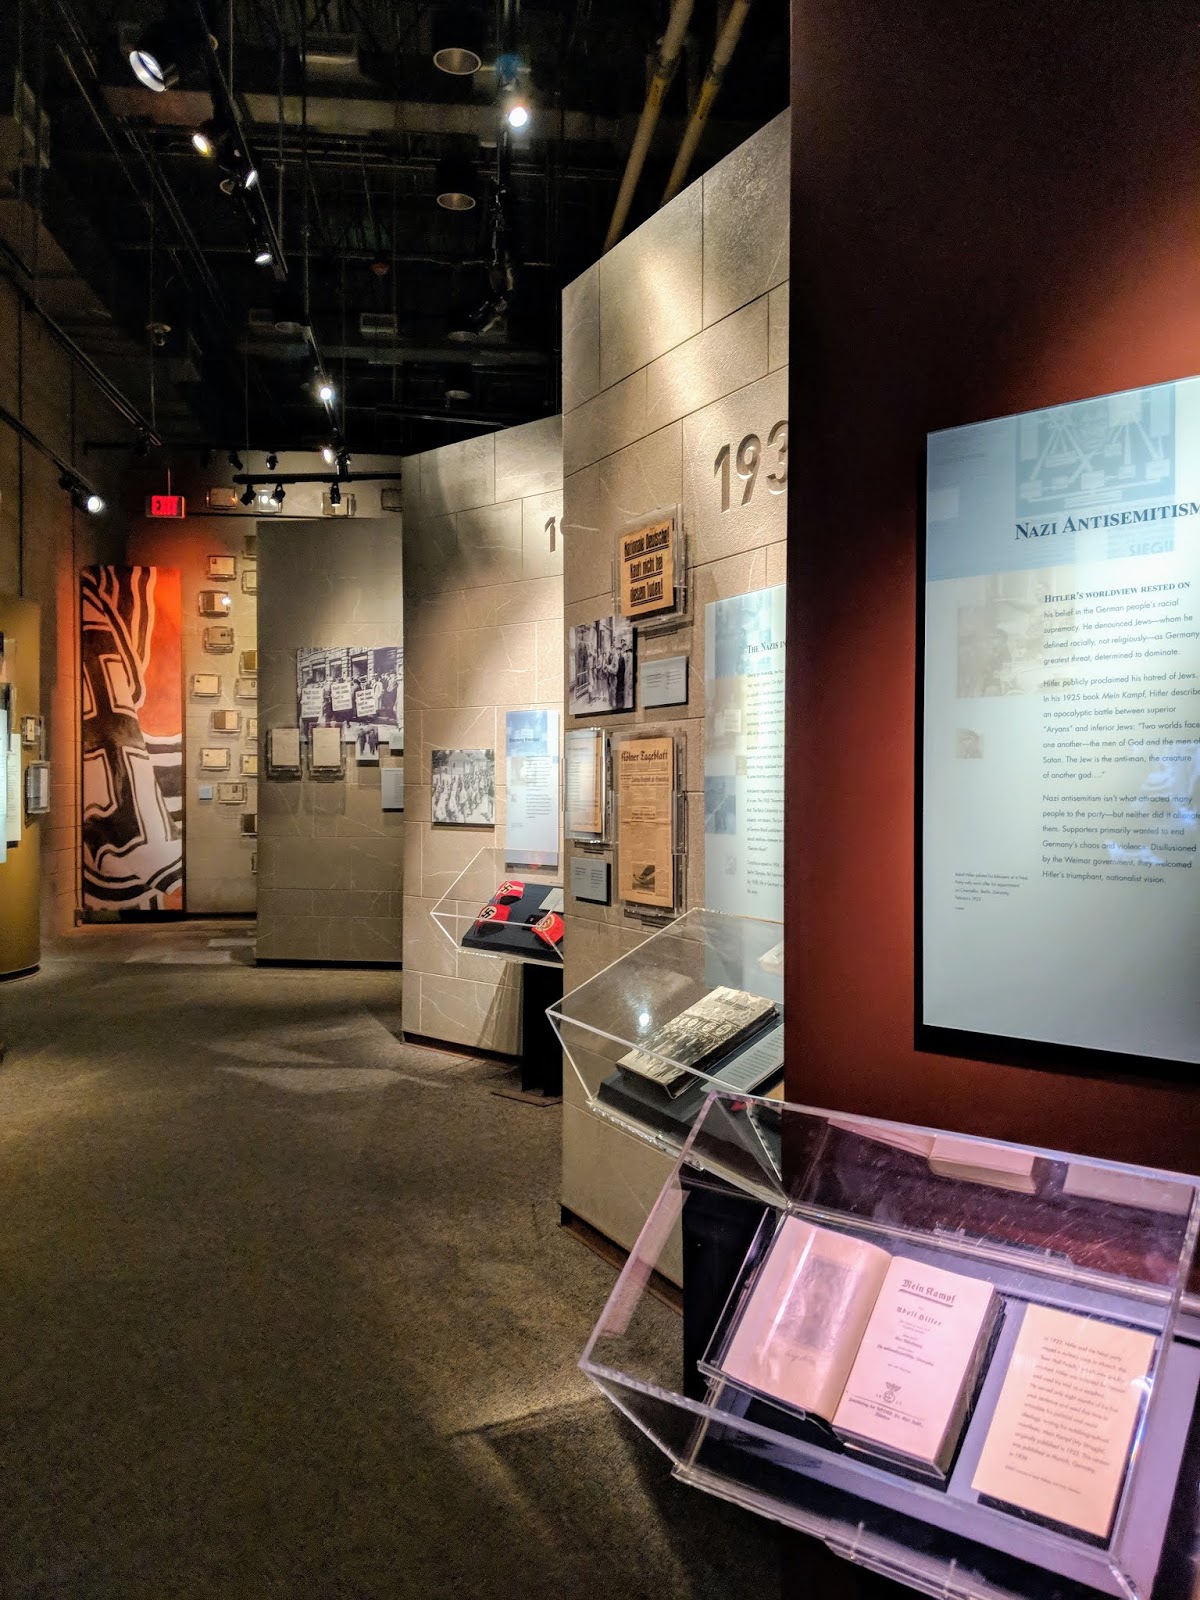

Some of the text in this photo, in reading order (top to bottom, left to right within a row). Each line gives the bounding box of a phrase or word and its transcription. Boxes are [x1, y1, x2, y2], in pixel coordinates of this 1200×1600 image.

[1044, 592, 1084, 603] HITLER'S
[1086, 587, 1138, 599] WORLDVIEW
[1141, 584, 1175, 593] RESTED
[1055, 609, 1074, 617] belief
[1096, 605, 1124, 613] German
[1126, 602, 1156, 612] people's
[1158, 599, 1179, 607] racial
[1044, 625, 1079, 634] supremacy.
[1095, 619, 1132, 628] denounced
[1044, 640, 1068, 649] defined
[1070, 638, 1096, 647] racially,
[1044, 655, 1069, 665] greatest
[1071, 654, 1092, 662] threat,
[1095, 650, 1133, 660] determined
[1144, 648, 1180, 656] dominate.
[1063, 678, 1088, 687] publicly
[1091, 677, 1129, 686] proclaimed
[1144, 673, 1166, 681] hatred
[1083, 693, 1099, 701] book
[1122, 690, 1146, 699] Kampf,
[1054, 708, 1092, 718] apocalyptic
[1094, 707, 1113, 716] battle
[1115, 707, 1144, 715] between
[1147, 706, 1176, 714] superior
[1090, 723, 1115, 731] inferior
[1116, 723, 1135, 731] Jews:
[1158, 721, 1182, 729] worlds
[1185, 720, 1200, 728] face
[1146, 738, 1160, 746] and
[1162, 737, 1173, 745] the
[1043, 756, 1063, 764] Satan.
[1139, 795, 1169, 803] attracted
[1043, 810, 1065, 819] people
[1063, 825, 1098, 834] Supporters
[1100, 826, 1130, 835] primarily
[1133, 827, 1159, 835] wanted
[1043, 840, 1078, 849] Germany's
[1080, 841, 1099, 849] chaos
[1151, 843, 1196, 852] Disillusioned
[1043, 855, 1050, 864] by
[1155, 860, 1192, 868] welcomed
[1043, 871, 1064, 879] Hitler's
[1066, 872, 1103, 881] triumphant,
[1106, 874, 1141, 883] nationalist
[902, 1279, 924, 1292] Mein
